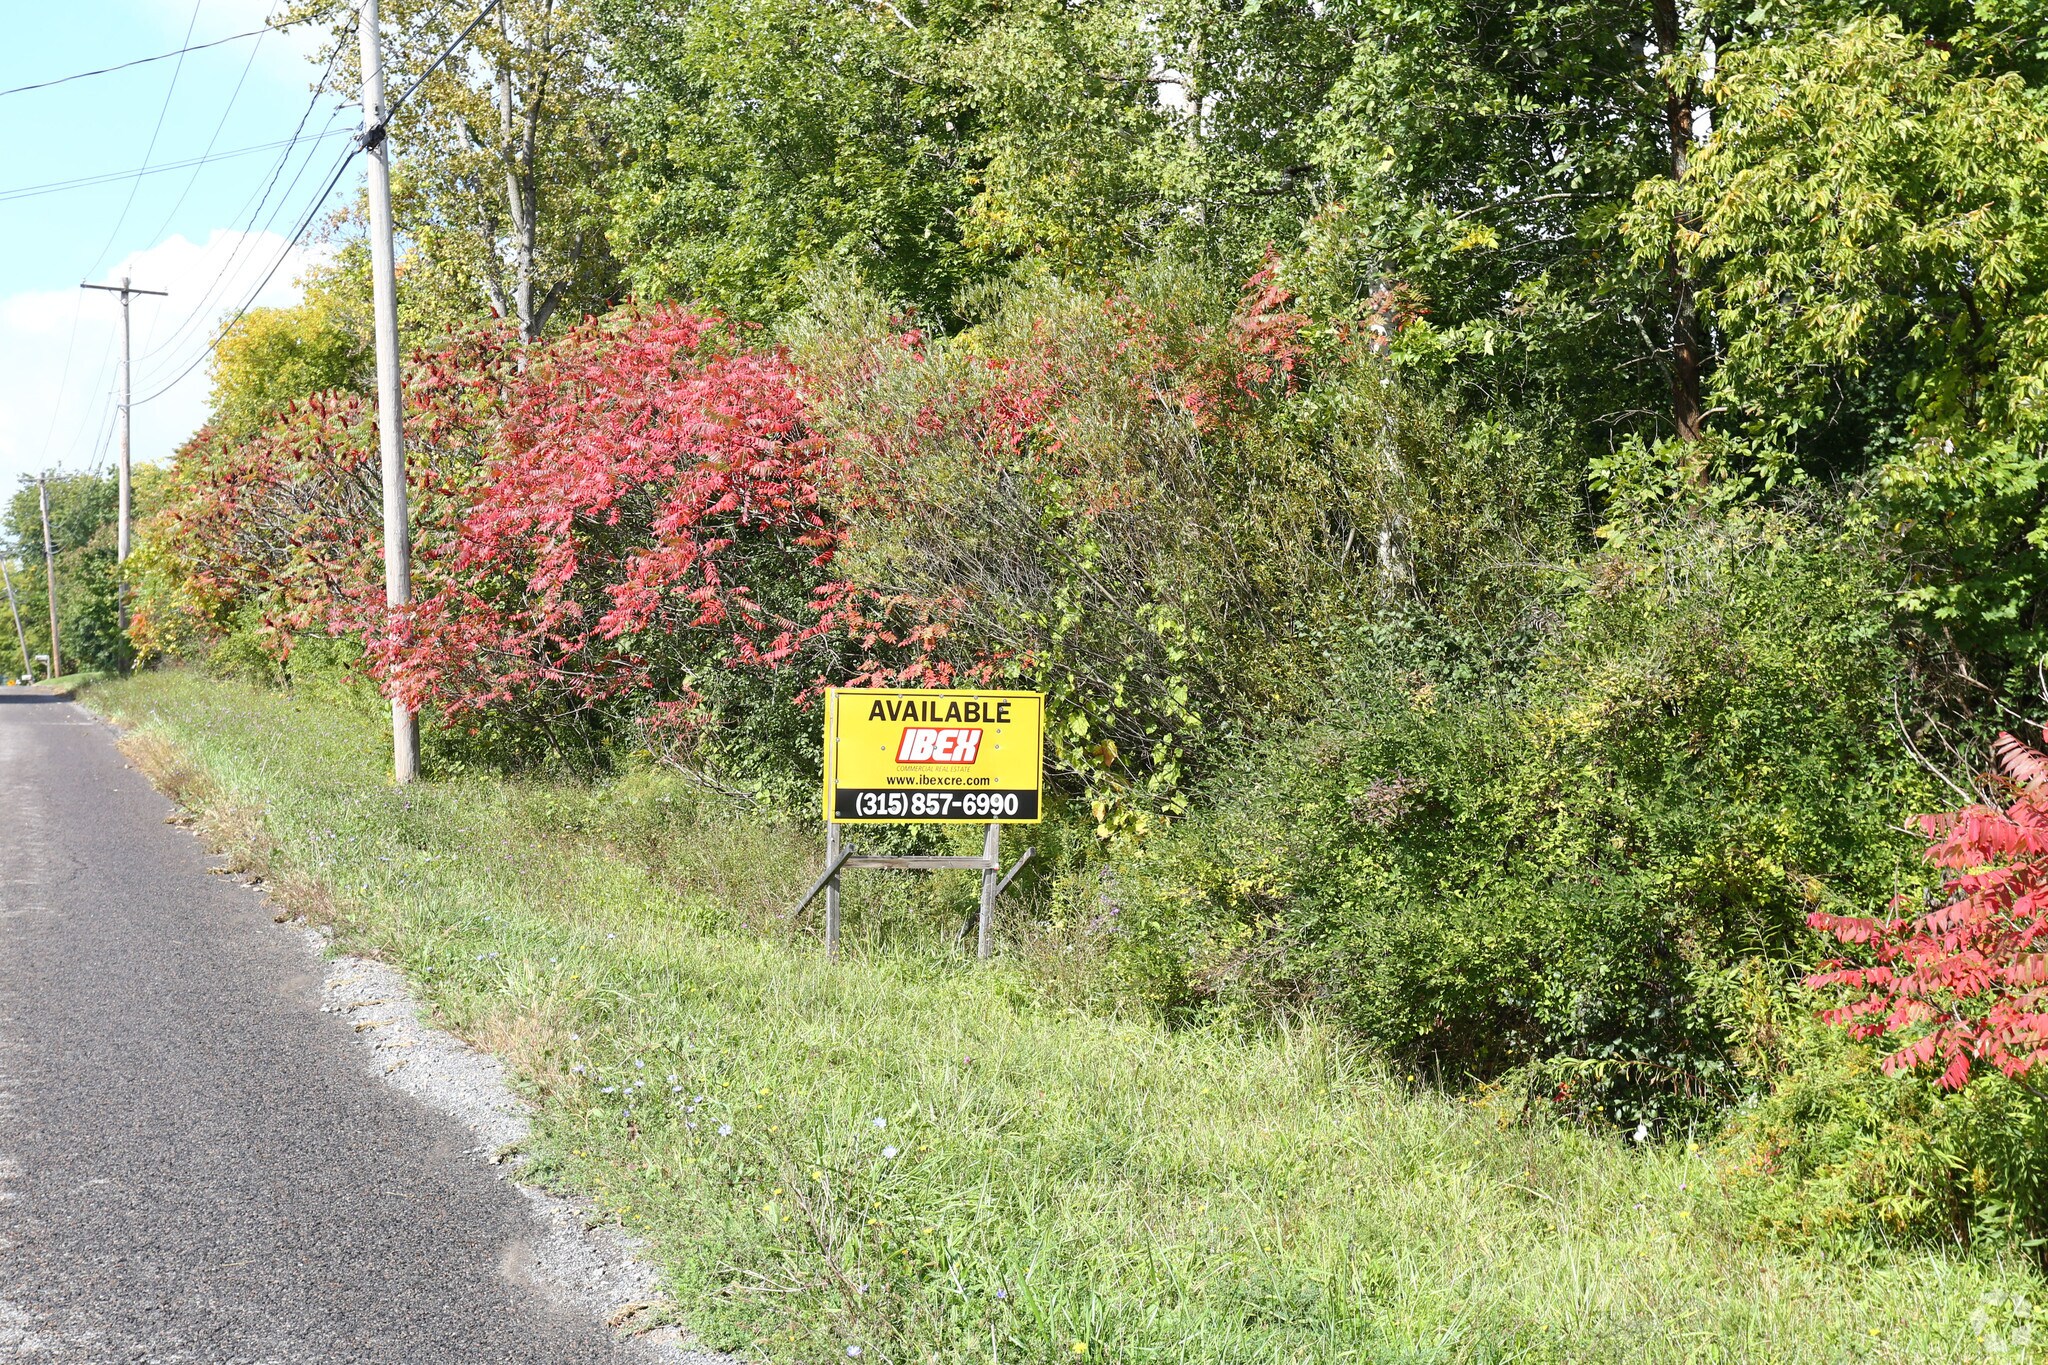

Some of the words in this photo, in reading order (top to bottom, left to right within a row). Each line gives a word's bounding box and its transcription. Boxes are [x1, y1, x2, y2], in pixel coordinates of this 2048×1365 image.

[868, 699, 1012, 723] AVAILABLE
[898, 728, 982, 762] IBEX
[935, 765, 950, 773] REAL
[886, 774, 990, 786] www.ibexcre.com
